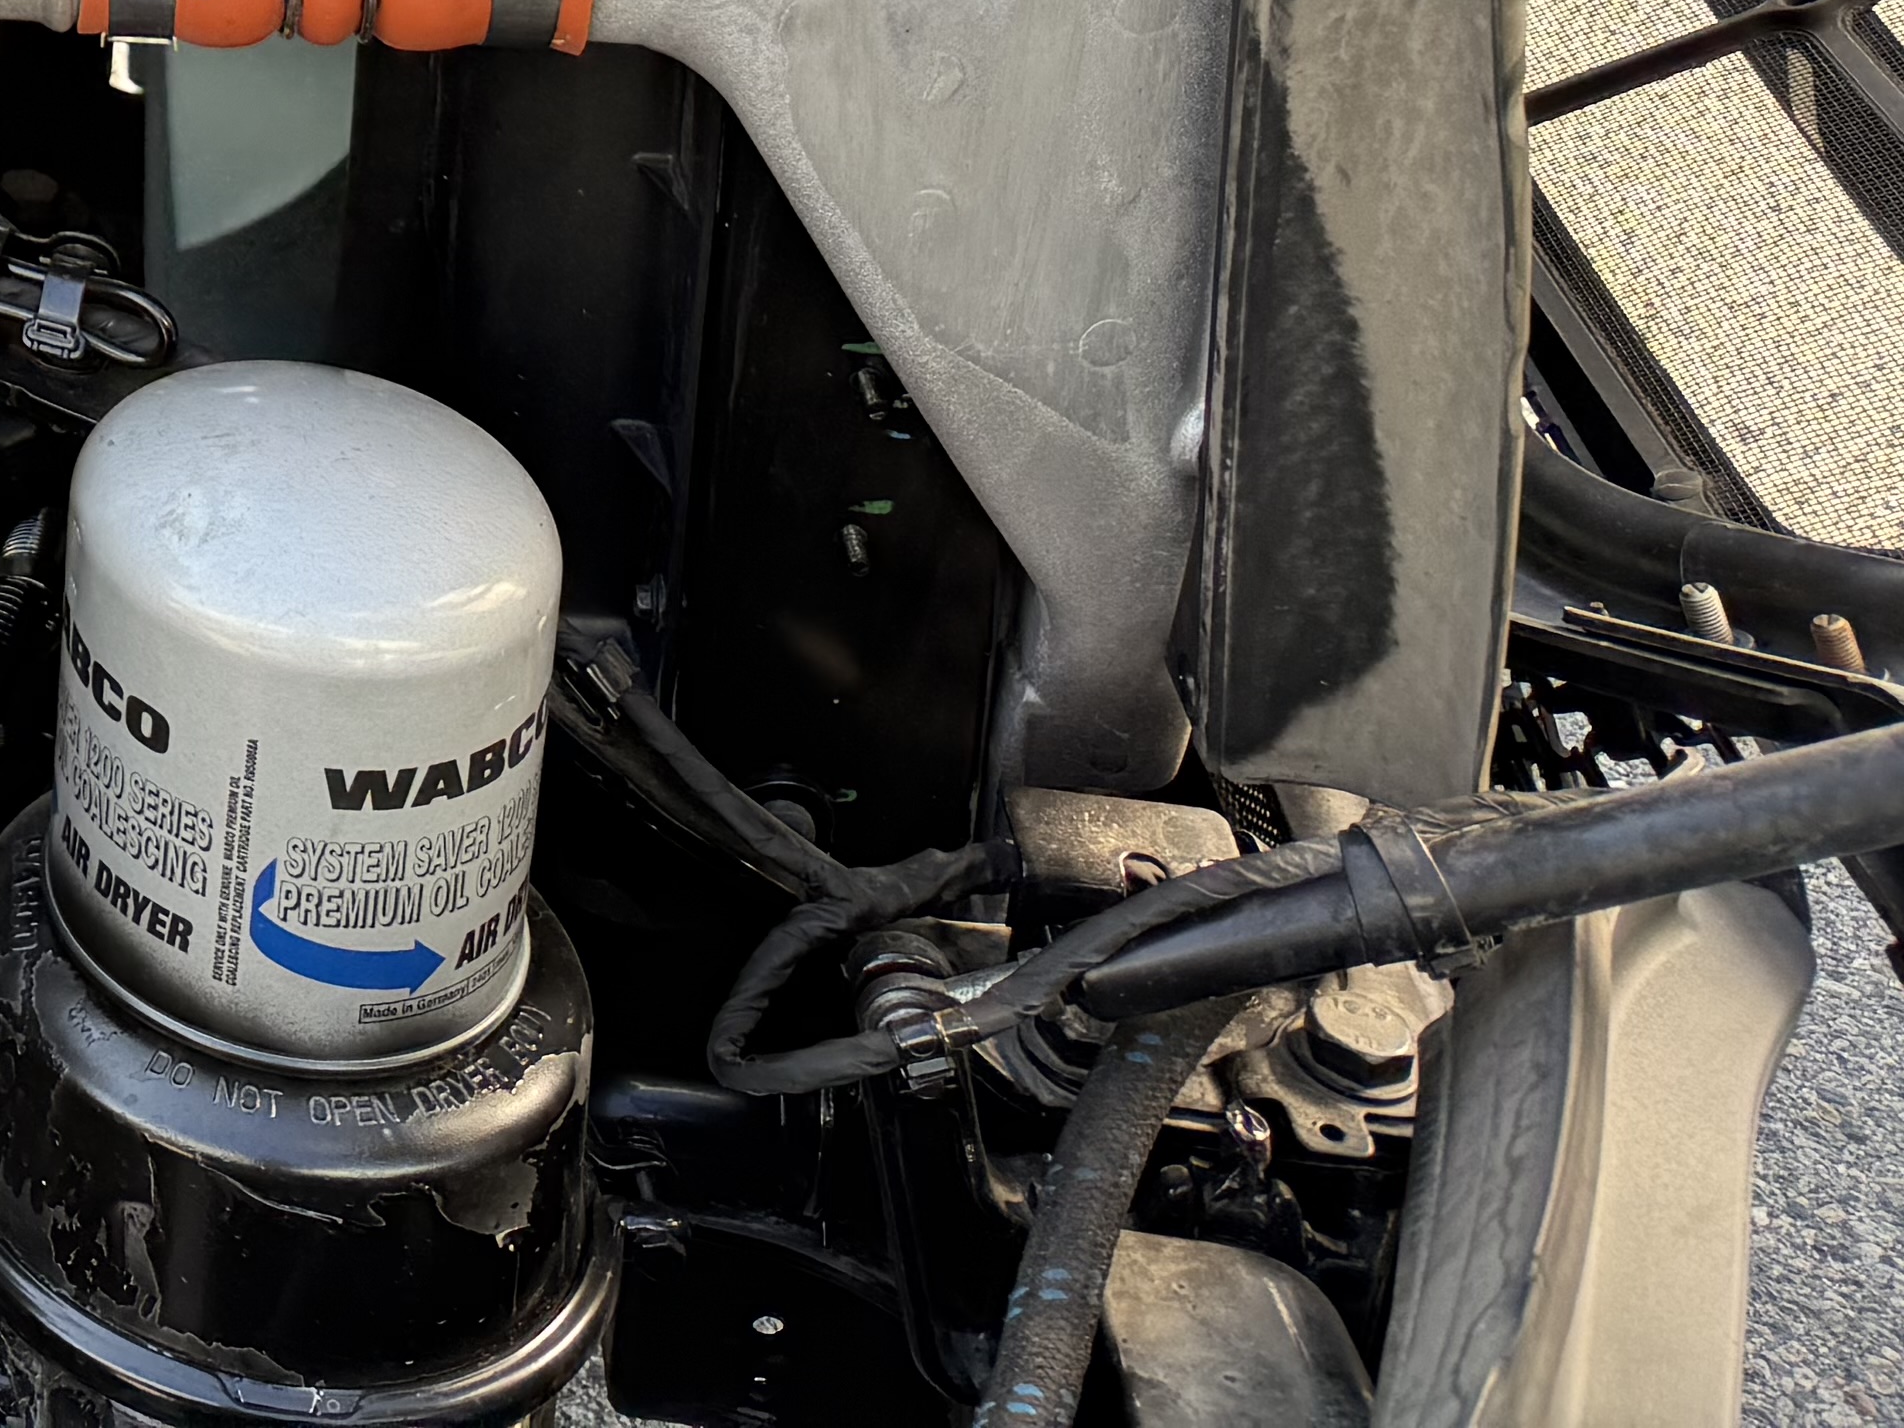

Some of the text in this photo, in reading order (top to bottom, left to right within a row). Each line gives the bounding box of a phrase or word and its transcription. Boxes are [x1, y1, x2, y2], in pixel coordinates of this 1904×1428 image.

[71, 755, 207, 897] COALESCING
[129, 771, 214, 853] SERIES
[223, 832, 235, 862] WABCO
[225, 792, 239, 830] PREMIUM
[284, 832, 407, 885] SYSTEM
[412, 808, 491, 877] SAVER
[61, 814, 91, 879] AIR
[94, 858, 193, 954] DRYER
[230, 877, 246, 935] REPLACEMENT
[241, 802, 253, 823] PART
[278, 877, 424, 929] PREMIUM
[429, 864, 469, 914] OIL
[456, 917, 499, 972] AIR
[363, 1003, 398, 1023] Made
[401, 998, 414, 1014] in
[416, 983, 467, 1011] Germany
[145, 1048, 195, 1089] DO
[213, 1075, 284, 1121] NOT
[310, 1093, 400, 1127] OPEN
[412, 1055, 510, 1117] DRYER
